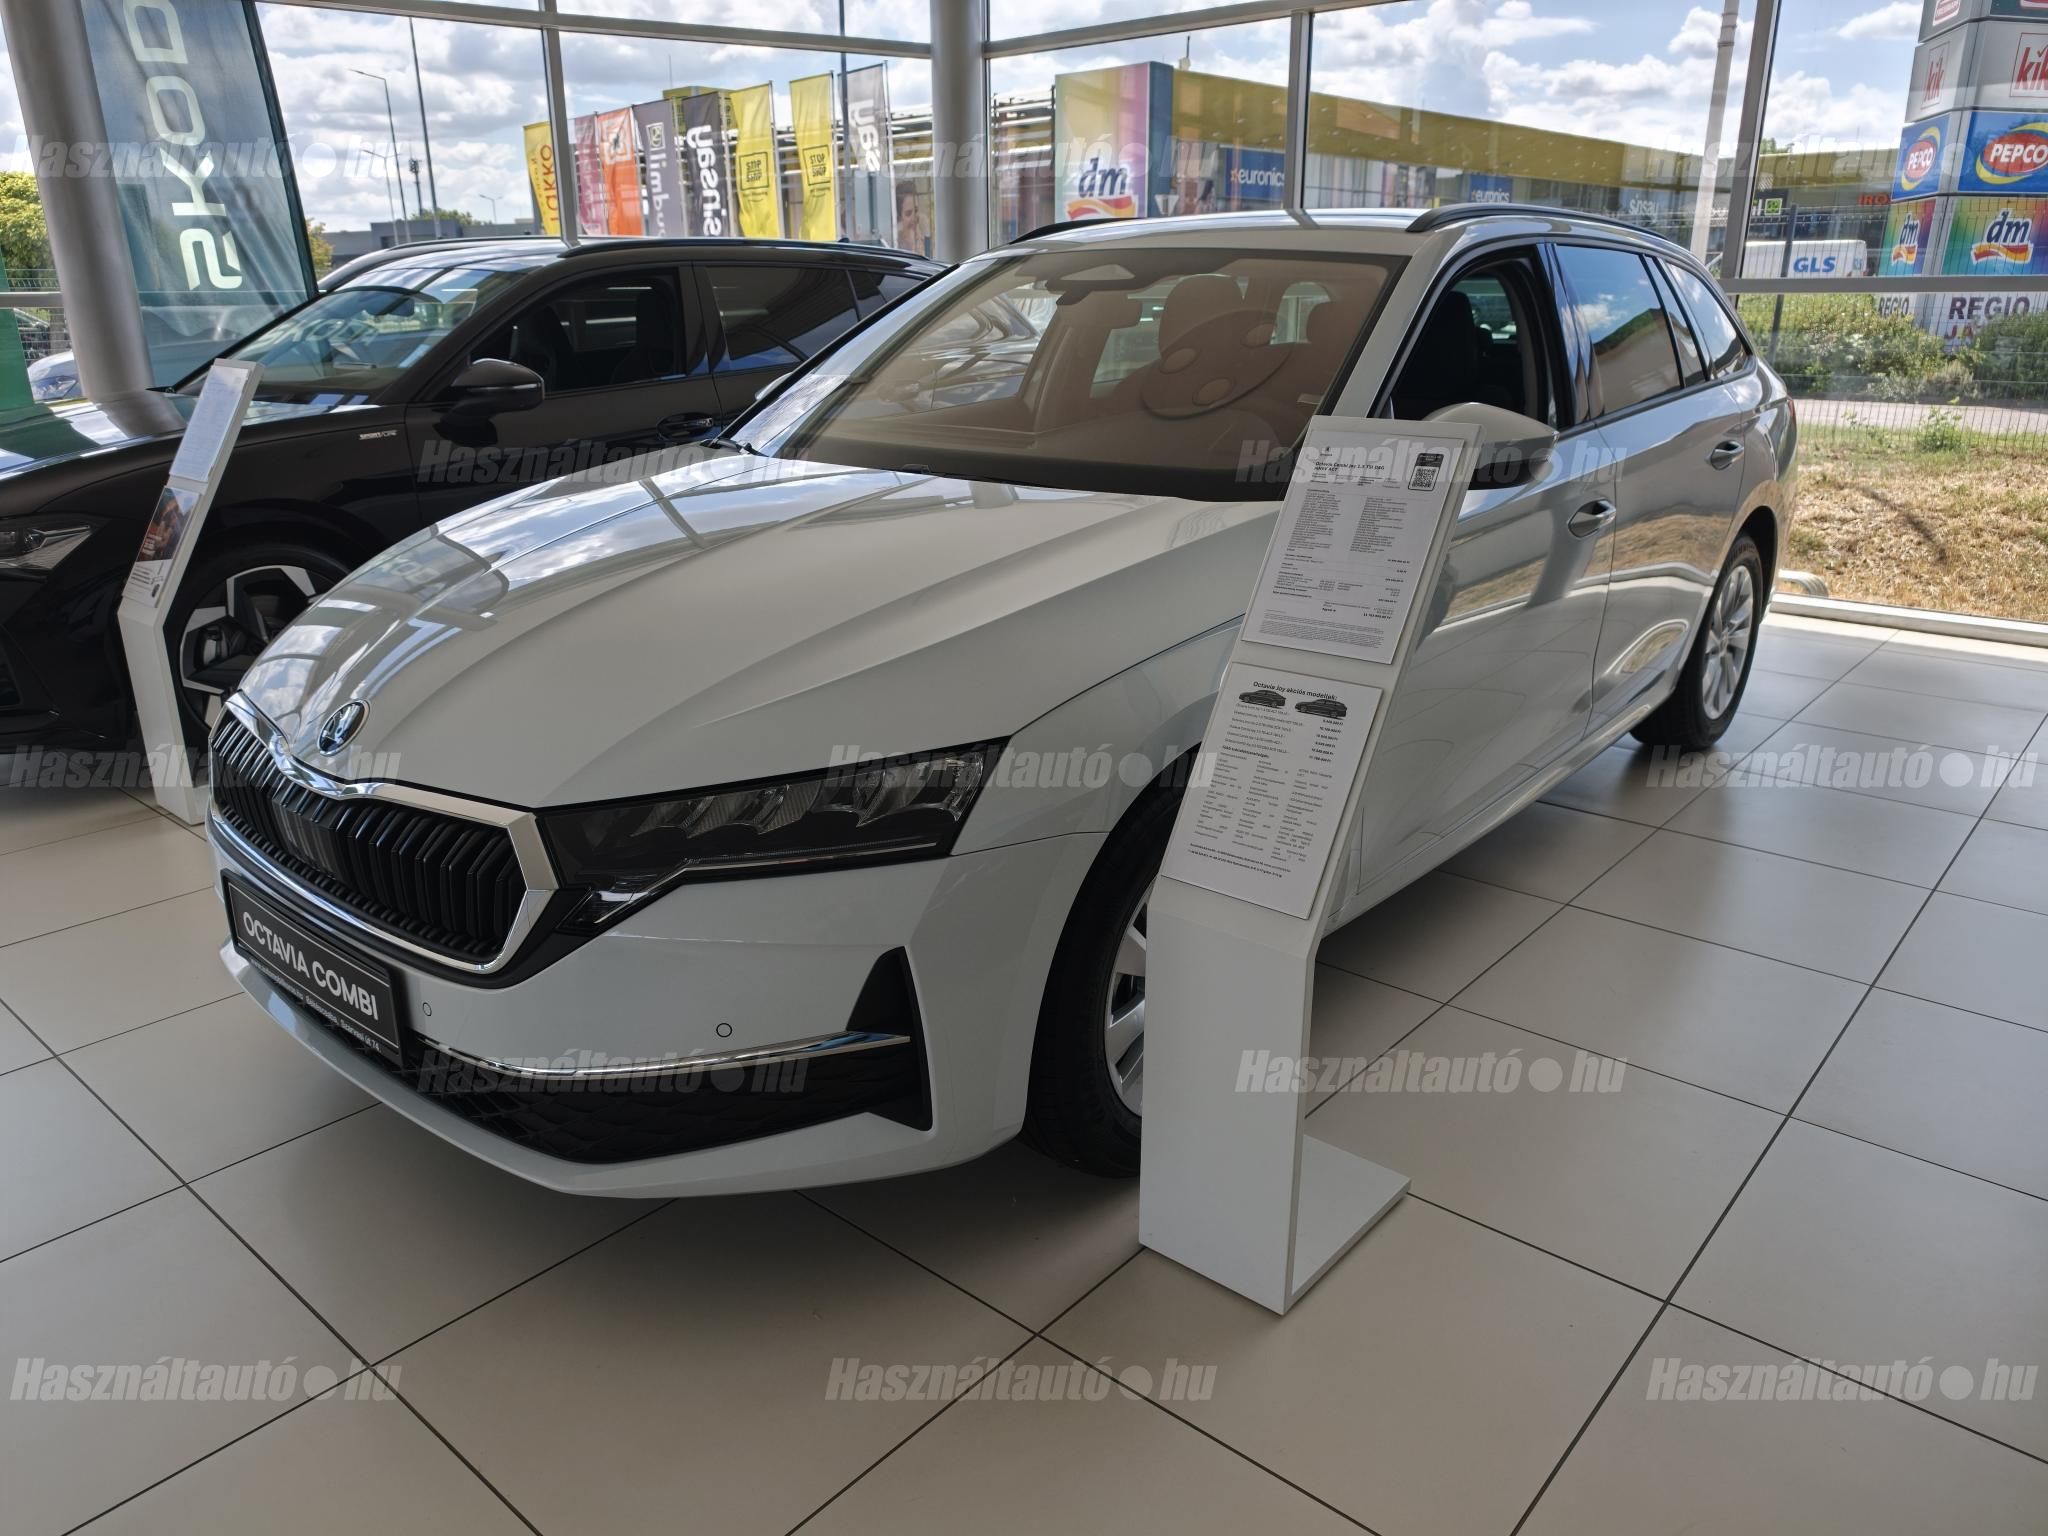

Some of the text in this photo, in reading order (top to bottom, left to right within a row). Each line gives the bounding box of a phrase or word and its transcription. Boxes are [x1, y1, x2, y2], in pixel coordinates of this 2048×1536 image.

[1908, 146, 1934, 171] PEPCO
[1989, 143, 2048, 164] PEPCO
[1077, 157, 1128, 198] dm
[1900, 213, 1919, 244] dm
[1986, 211, 2030, 243] dm
[1793, 256, 1836, 273] GLS
[243, 911, 310, 979] OCTAVIA
[312, 961, 379, 1021] COMBI
